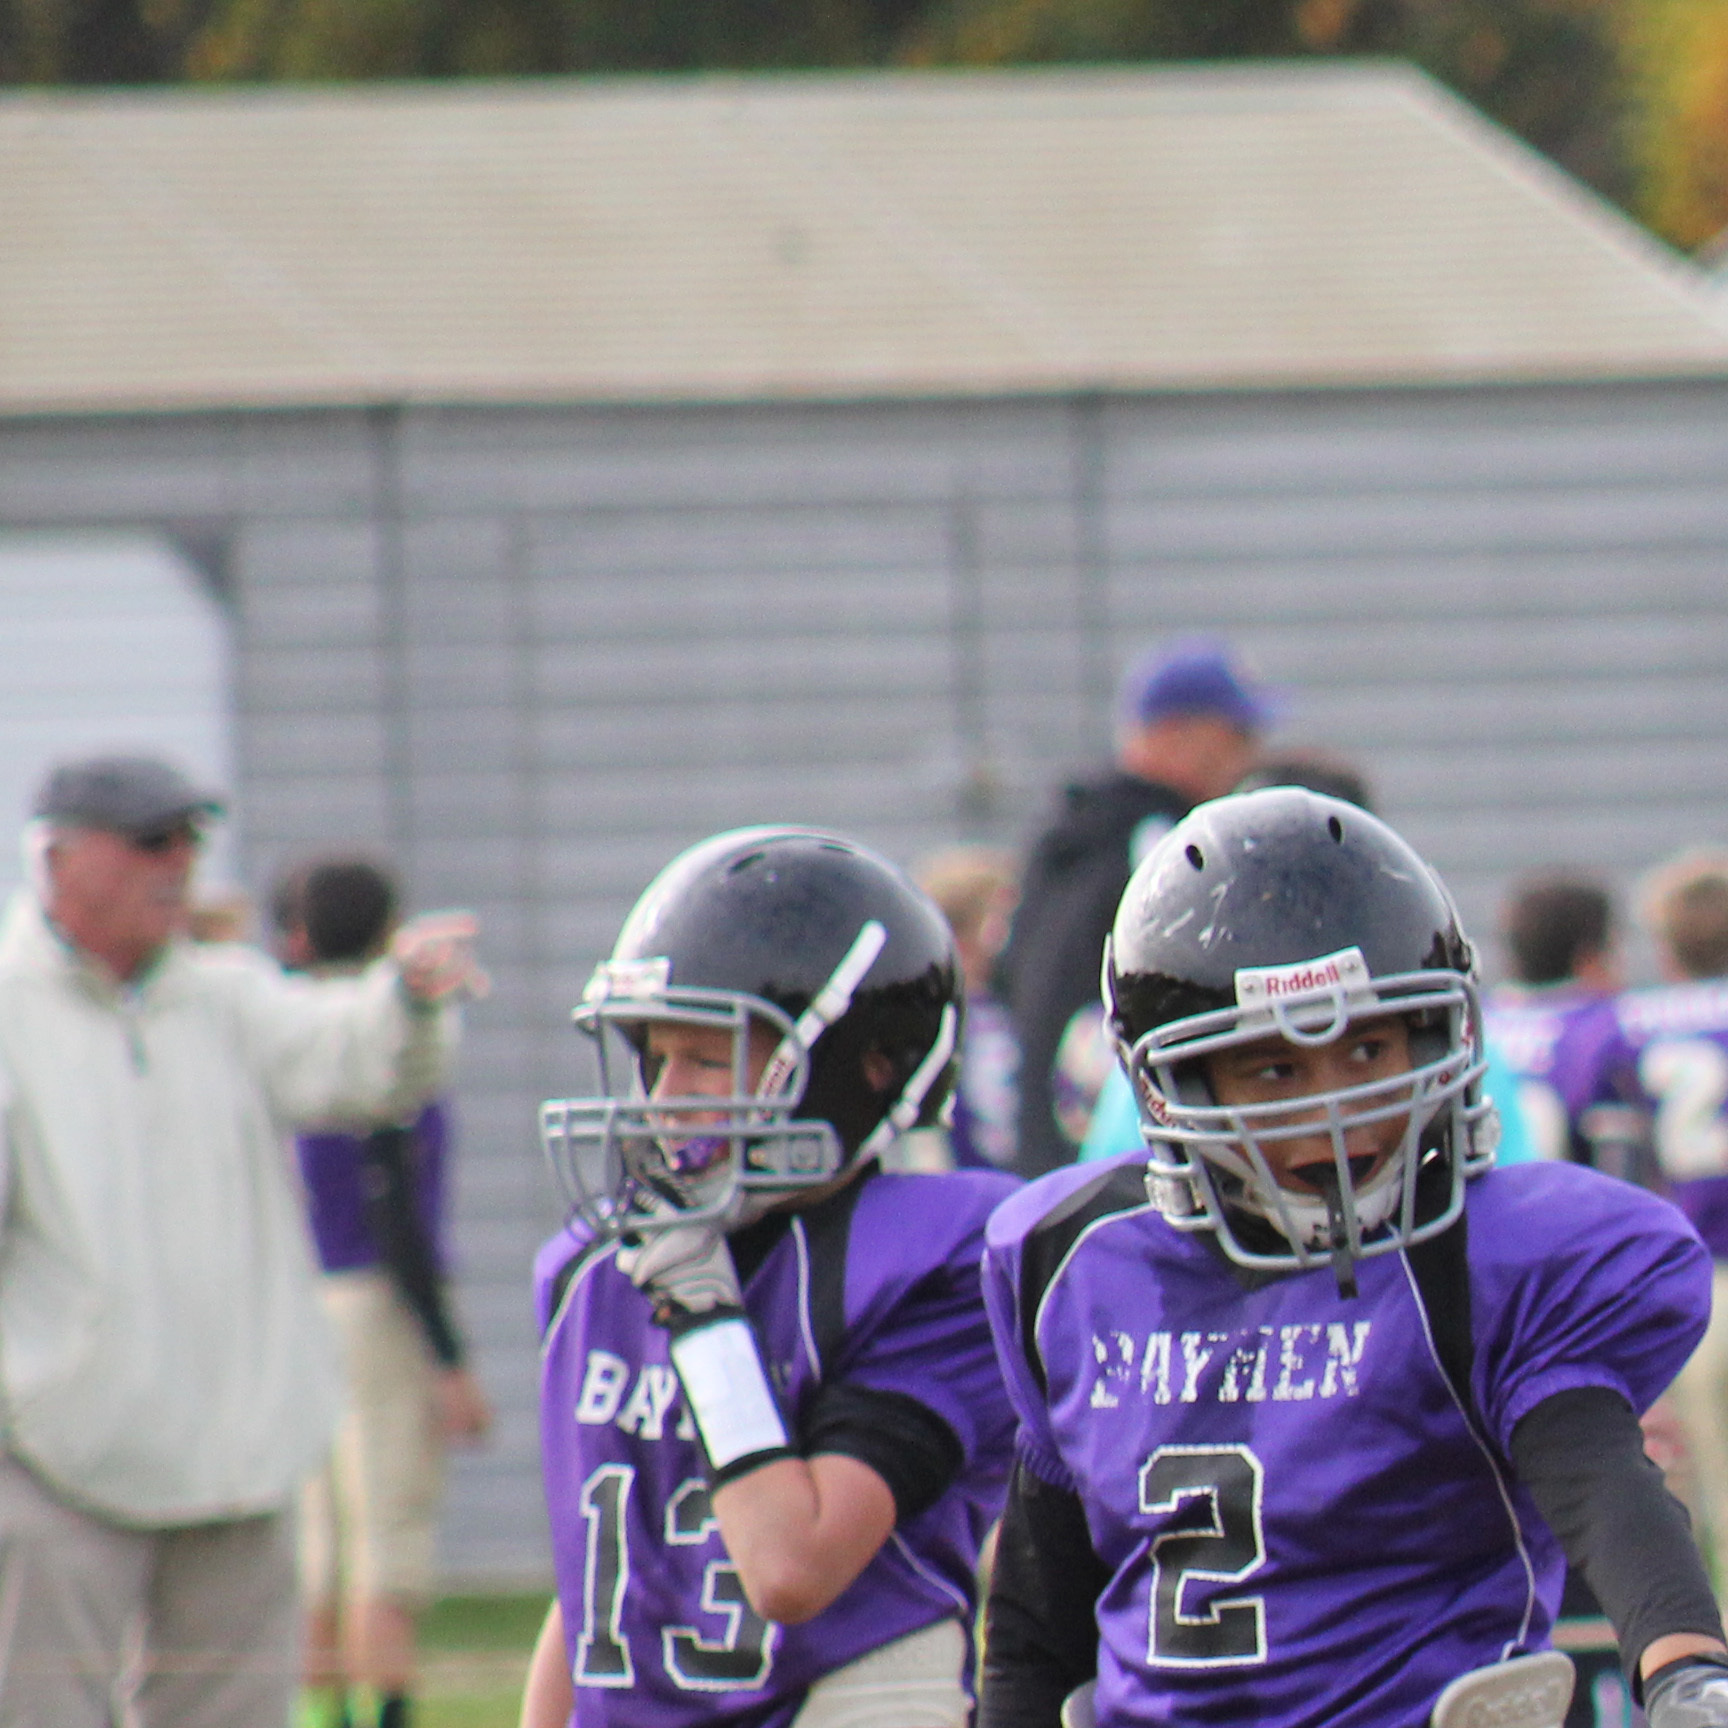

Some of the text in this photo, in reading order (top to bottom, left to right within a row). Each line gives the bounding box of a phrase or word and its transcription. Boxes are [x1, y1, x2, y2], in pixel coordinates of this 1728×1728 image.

[1265, 963, 1341, 996] Riddell
[574, 1462, 783, 1692] 13
[1137, 1443, 1267, 1667] 2
